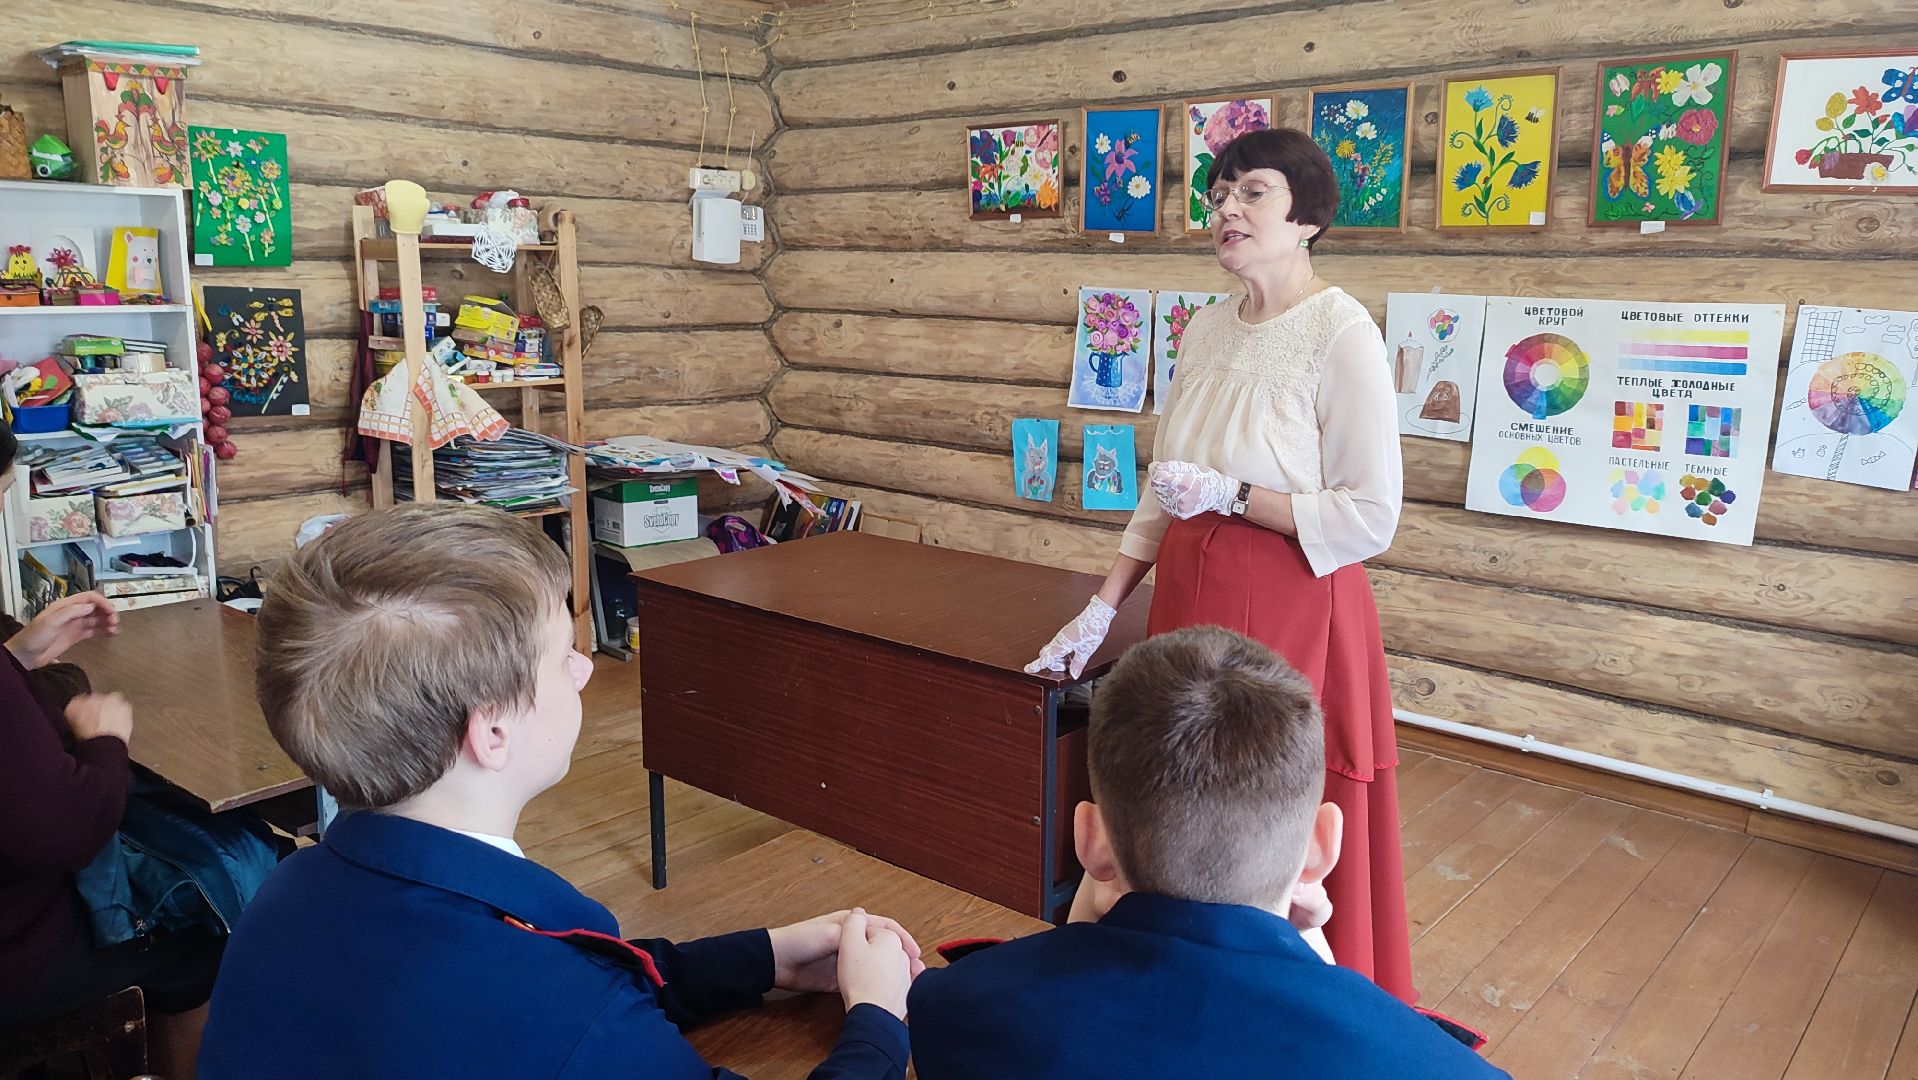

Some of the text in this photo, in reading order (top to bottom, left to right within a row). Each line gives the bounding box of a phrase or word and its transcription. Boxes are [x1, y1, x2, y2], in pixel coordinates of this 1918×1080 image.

[1524, 306, 1584, 317] ЦВЕТОВОЙ
[1621, 311, 1749, 323] ЦВЕТОВЫЕ ОТТЕНКИ
[1538, 316, 1568, 326] КРУГ
[1617, 376, 1663, 388] ТЕПЛЫЕ
[1652, 388, 1693, 398] ЦВЕТА
[1510, 422, 1574, 435] СМЕШЕНИЕ
[1498, 430, 1582, 445] ОСНОВНЫХ ЦВЕТОВ
[1608, 456, 1670, 470] ПАСТЕЛЬНЫЕ
[1684, 463, 1728, 476] ТЕМНЫЕ
